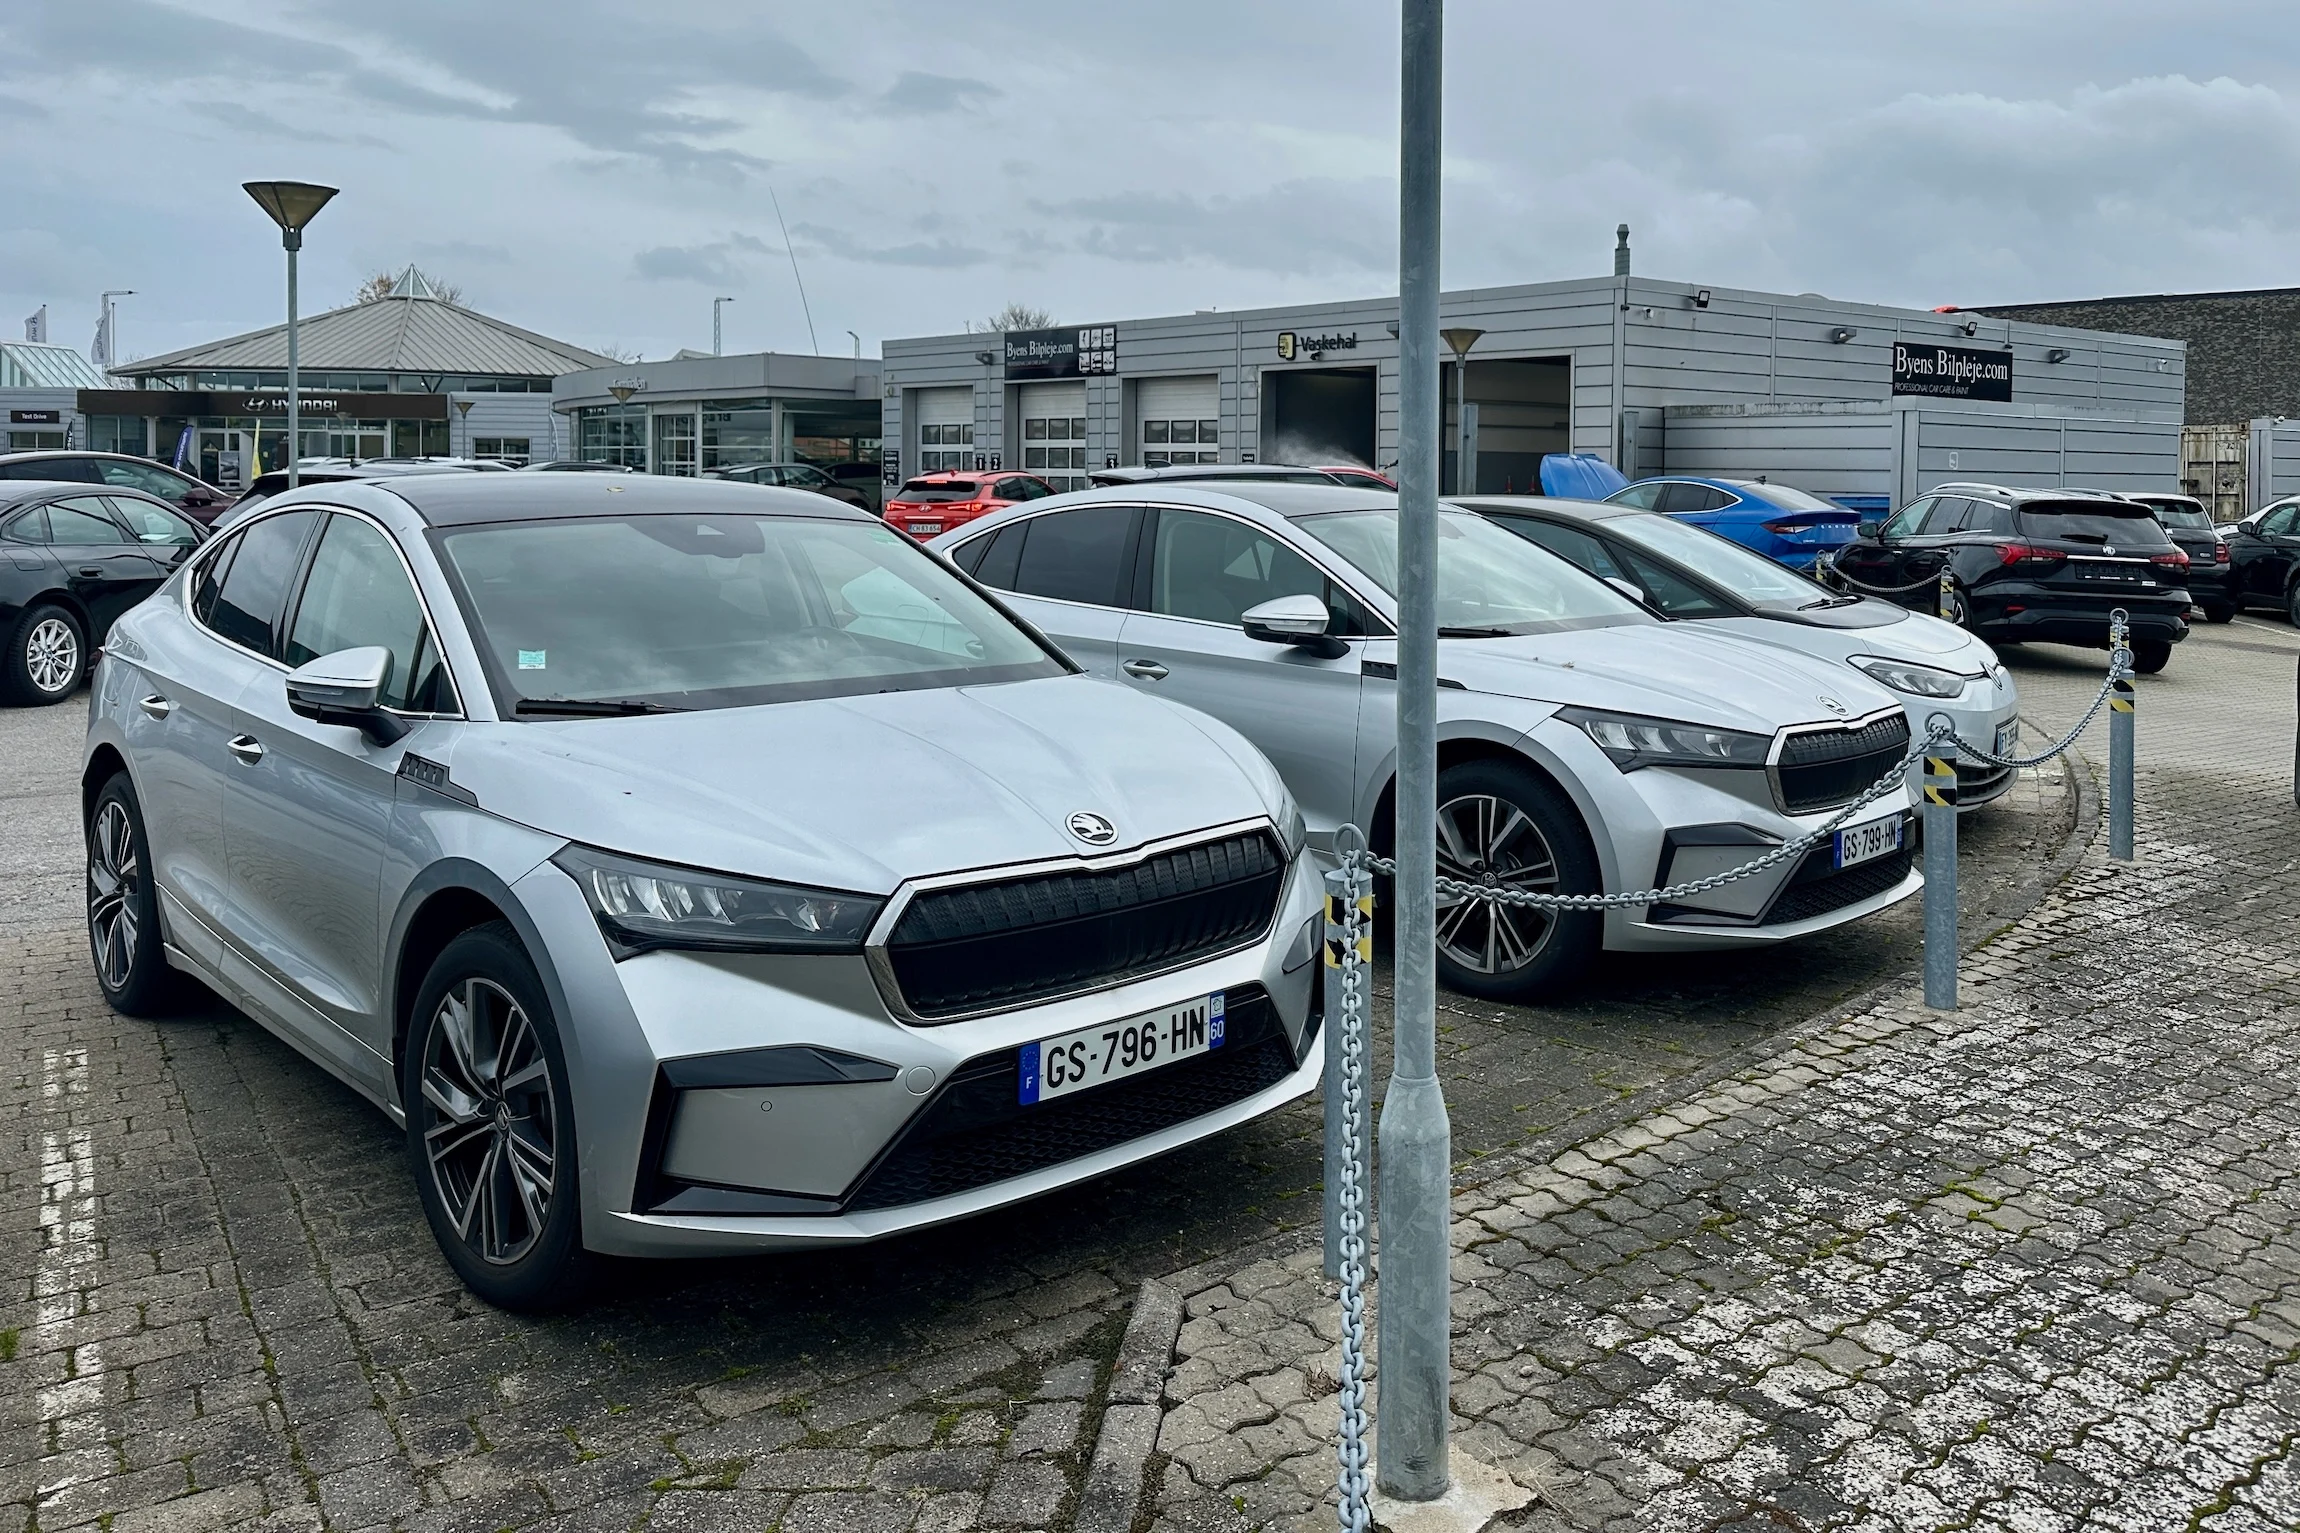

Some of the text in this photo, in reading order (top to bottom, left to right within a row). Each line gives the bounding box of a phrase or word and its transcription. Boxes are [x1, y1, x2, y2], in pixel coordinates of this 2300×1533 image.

[1006, 341, 1074, 359] Byens Bilpleje.com
[1300, 332, 1357, 352] Vaskehal
[1894, 346, 2008, 384] Byens Bilpleje.com
[1894, 382, 1928, 393] PROFESSIONAL
[1929, 384, 1939, 393] CAR
[1939, 384, 1951, 394] CARE
[271, 399, 337, 411] HYNDAI
[993, 458, 998, 469] 2
[1109, 459, 1115, 468] 3
[1844, 820, 1895, 860] GS-799-HN
[1026, 1005, 1224, 1089] F GS-796-HN 60
